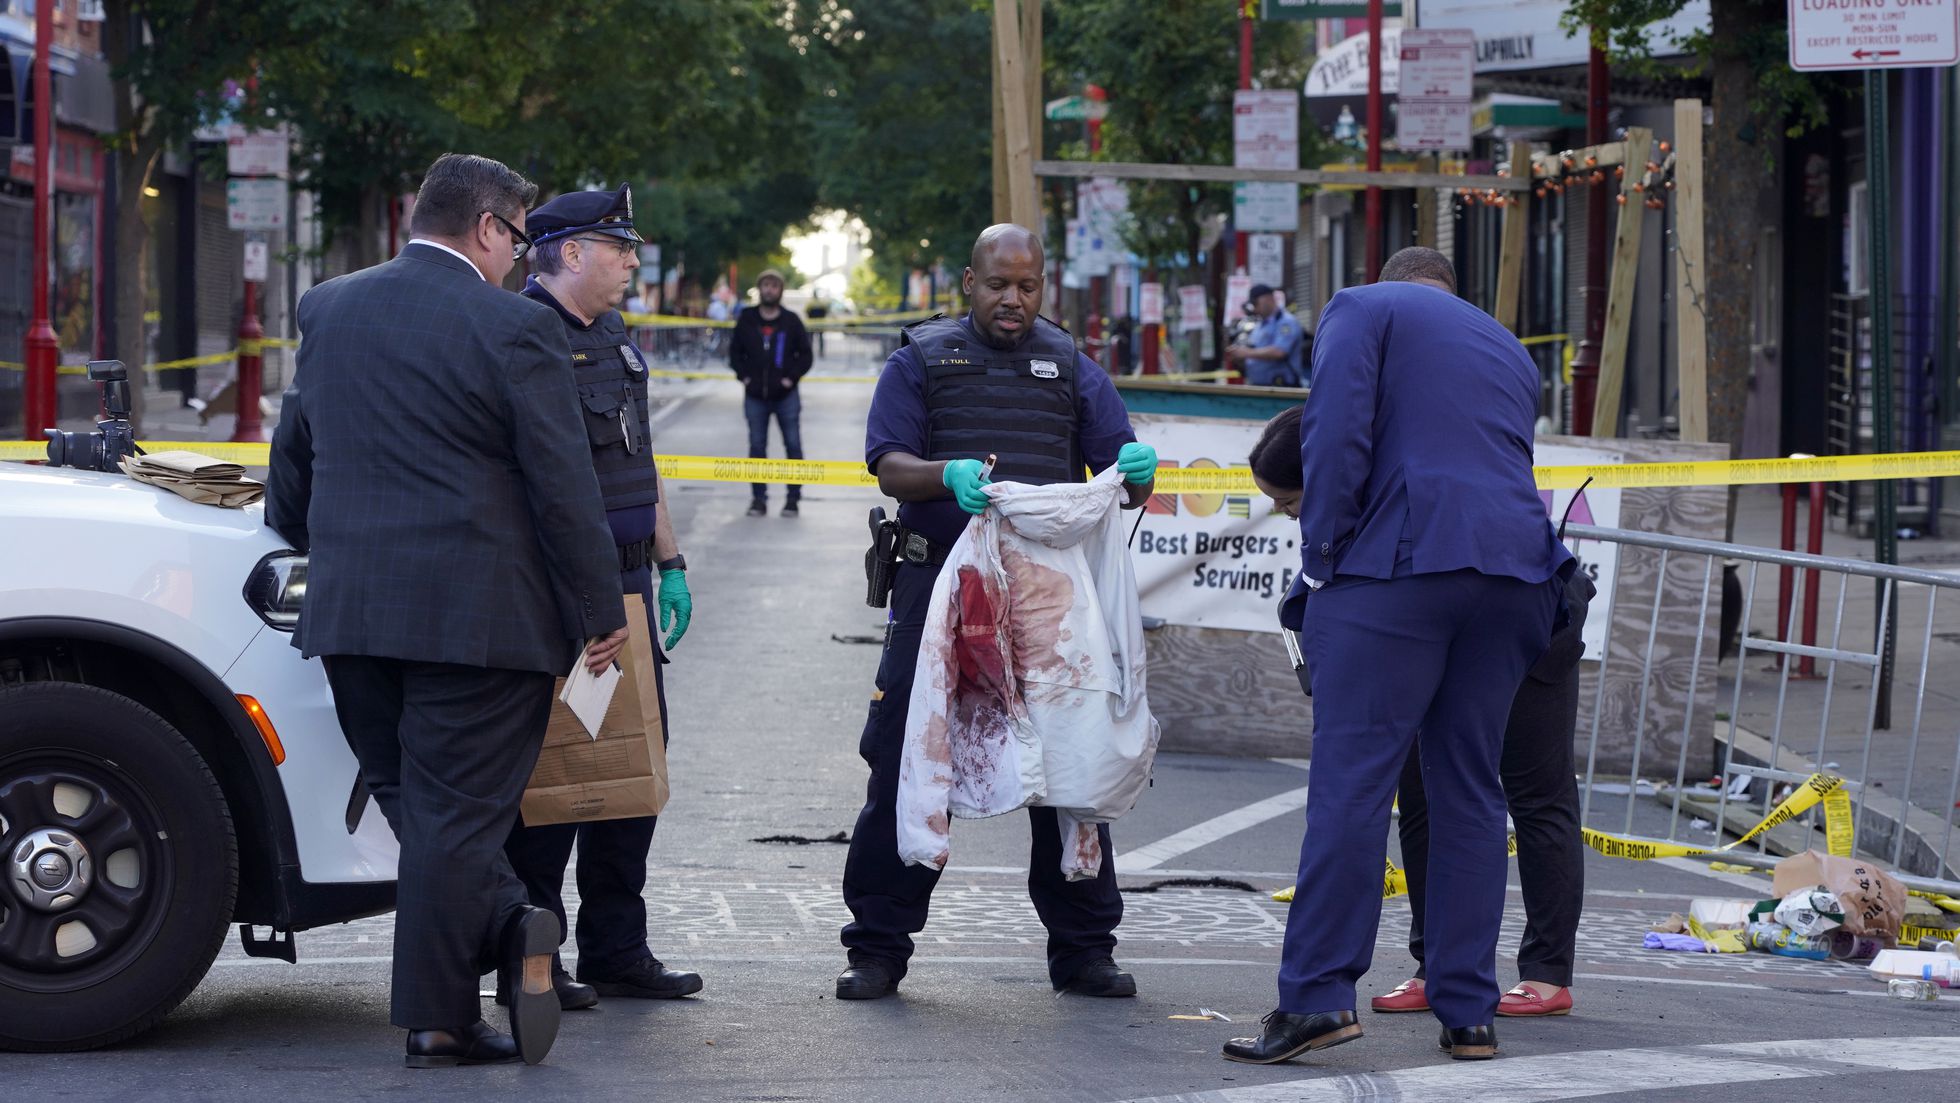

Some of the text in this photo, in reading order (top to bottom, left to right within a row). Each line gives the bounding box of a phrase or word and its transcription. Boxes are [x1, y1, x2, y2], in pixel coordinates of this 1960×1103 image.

[1843, 11, 1906, 22] 30 MIN LIMIT
[1852, 24, 1898, 33] MON-SUN
[1807, 33, 1938, 48] EXCEPT RESTRICTED HOURS
[1140, 530, 1278, 559] Best Burgers
[1193, 563, 1274, 598] Serving
[1593, 834, 1604, 853] DO
[1606, 839, 1625, 856] LINE
[1627, 843, 1656, 859] POLICE
